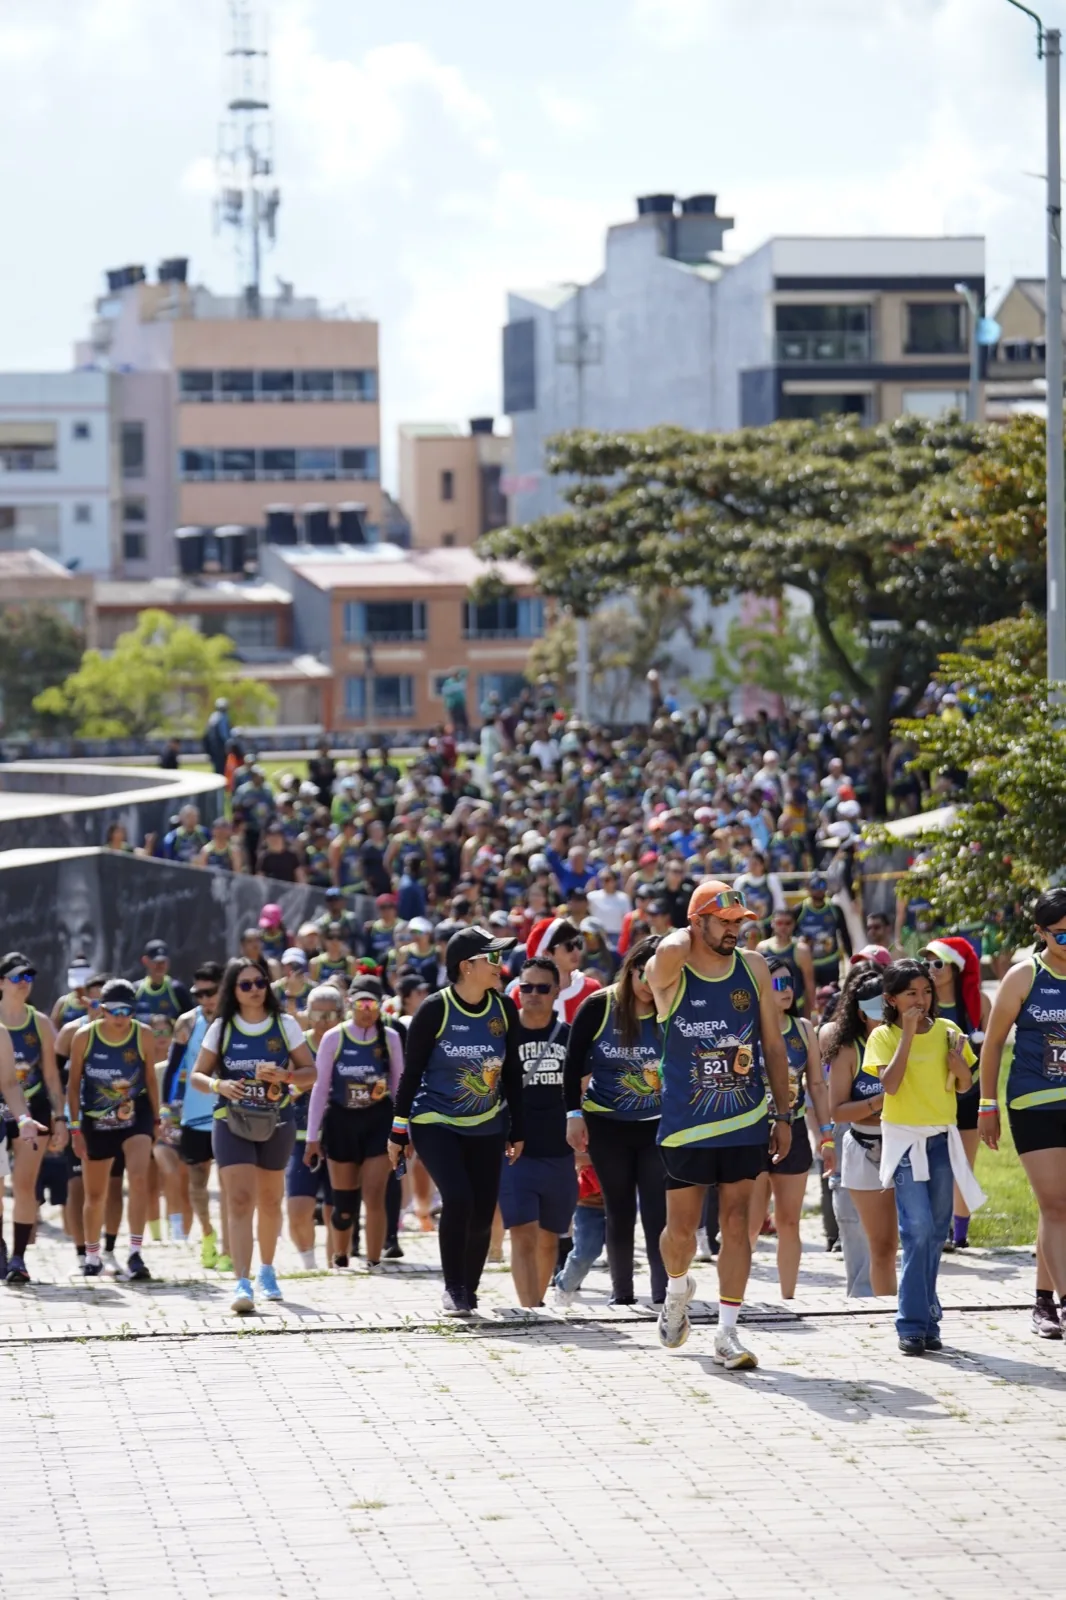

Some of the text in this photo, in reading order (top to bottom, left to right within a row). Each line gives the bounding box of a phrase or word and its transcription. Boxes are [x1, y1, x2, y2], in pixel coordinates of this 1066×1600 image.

[680, 1020, 728, 1032] CARRERA
[444, 1045, 494, 1053] CARRERA
[602, 1046, 656, 1055] CARRERA
[338, 1065, 375, 1073] CARRERA
[704, 1060, 728, 1074] 521
[245, 1086, 265, 1097] 213
[351, 1090, 369, 1100] 136
